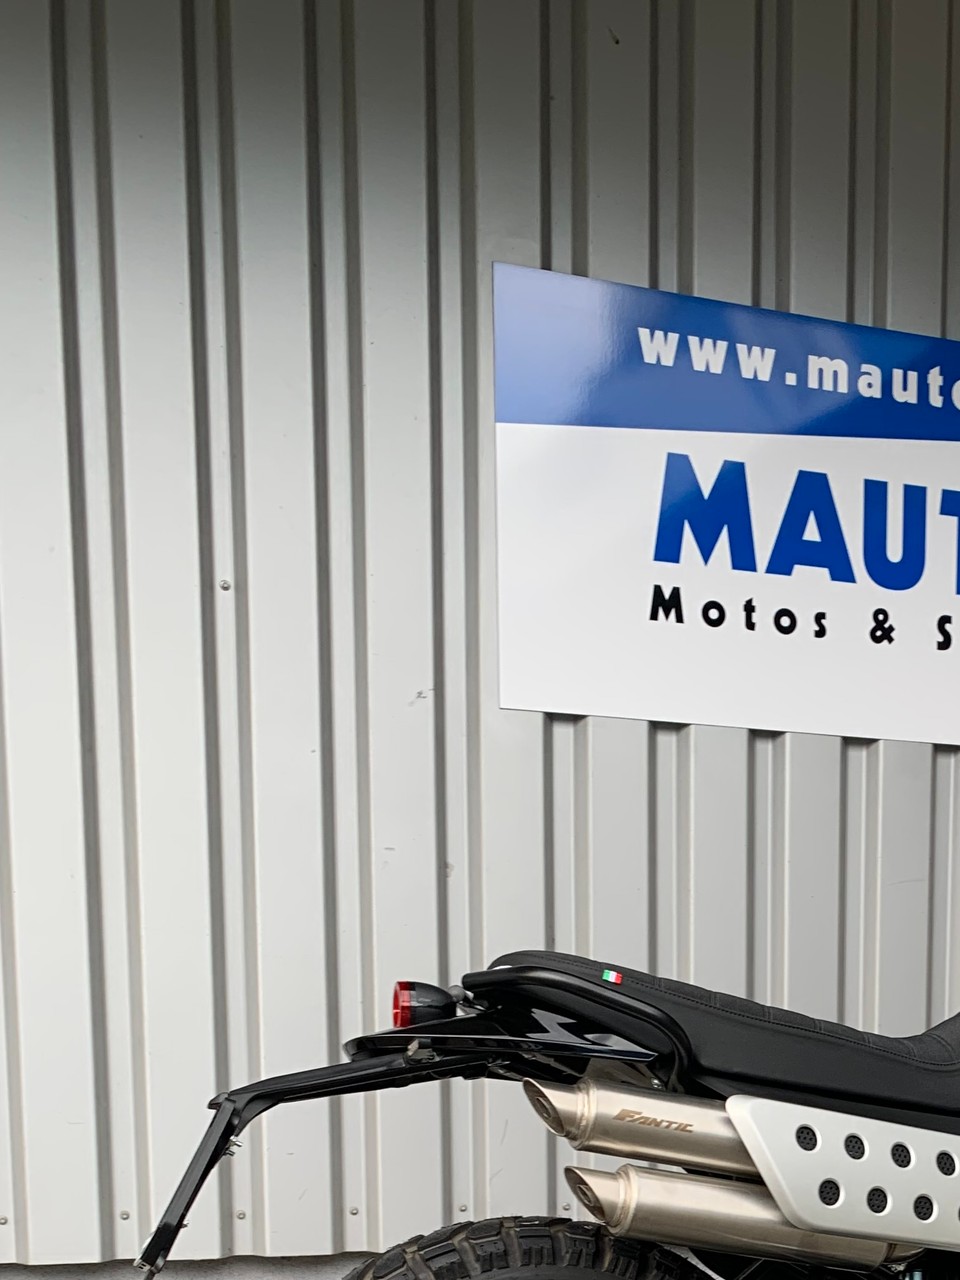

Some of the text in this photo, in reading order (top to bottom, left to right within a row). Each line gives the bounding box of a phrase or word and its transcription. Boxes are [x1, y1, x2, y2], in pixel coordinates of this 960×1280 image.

[649, 584, 827, 639] Motos
[869, 608, 895, 645] &
[612, 1108, 694, 1133] FANTIC
